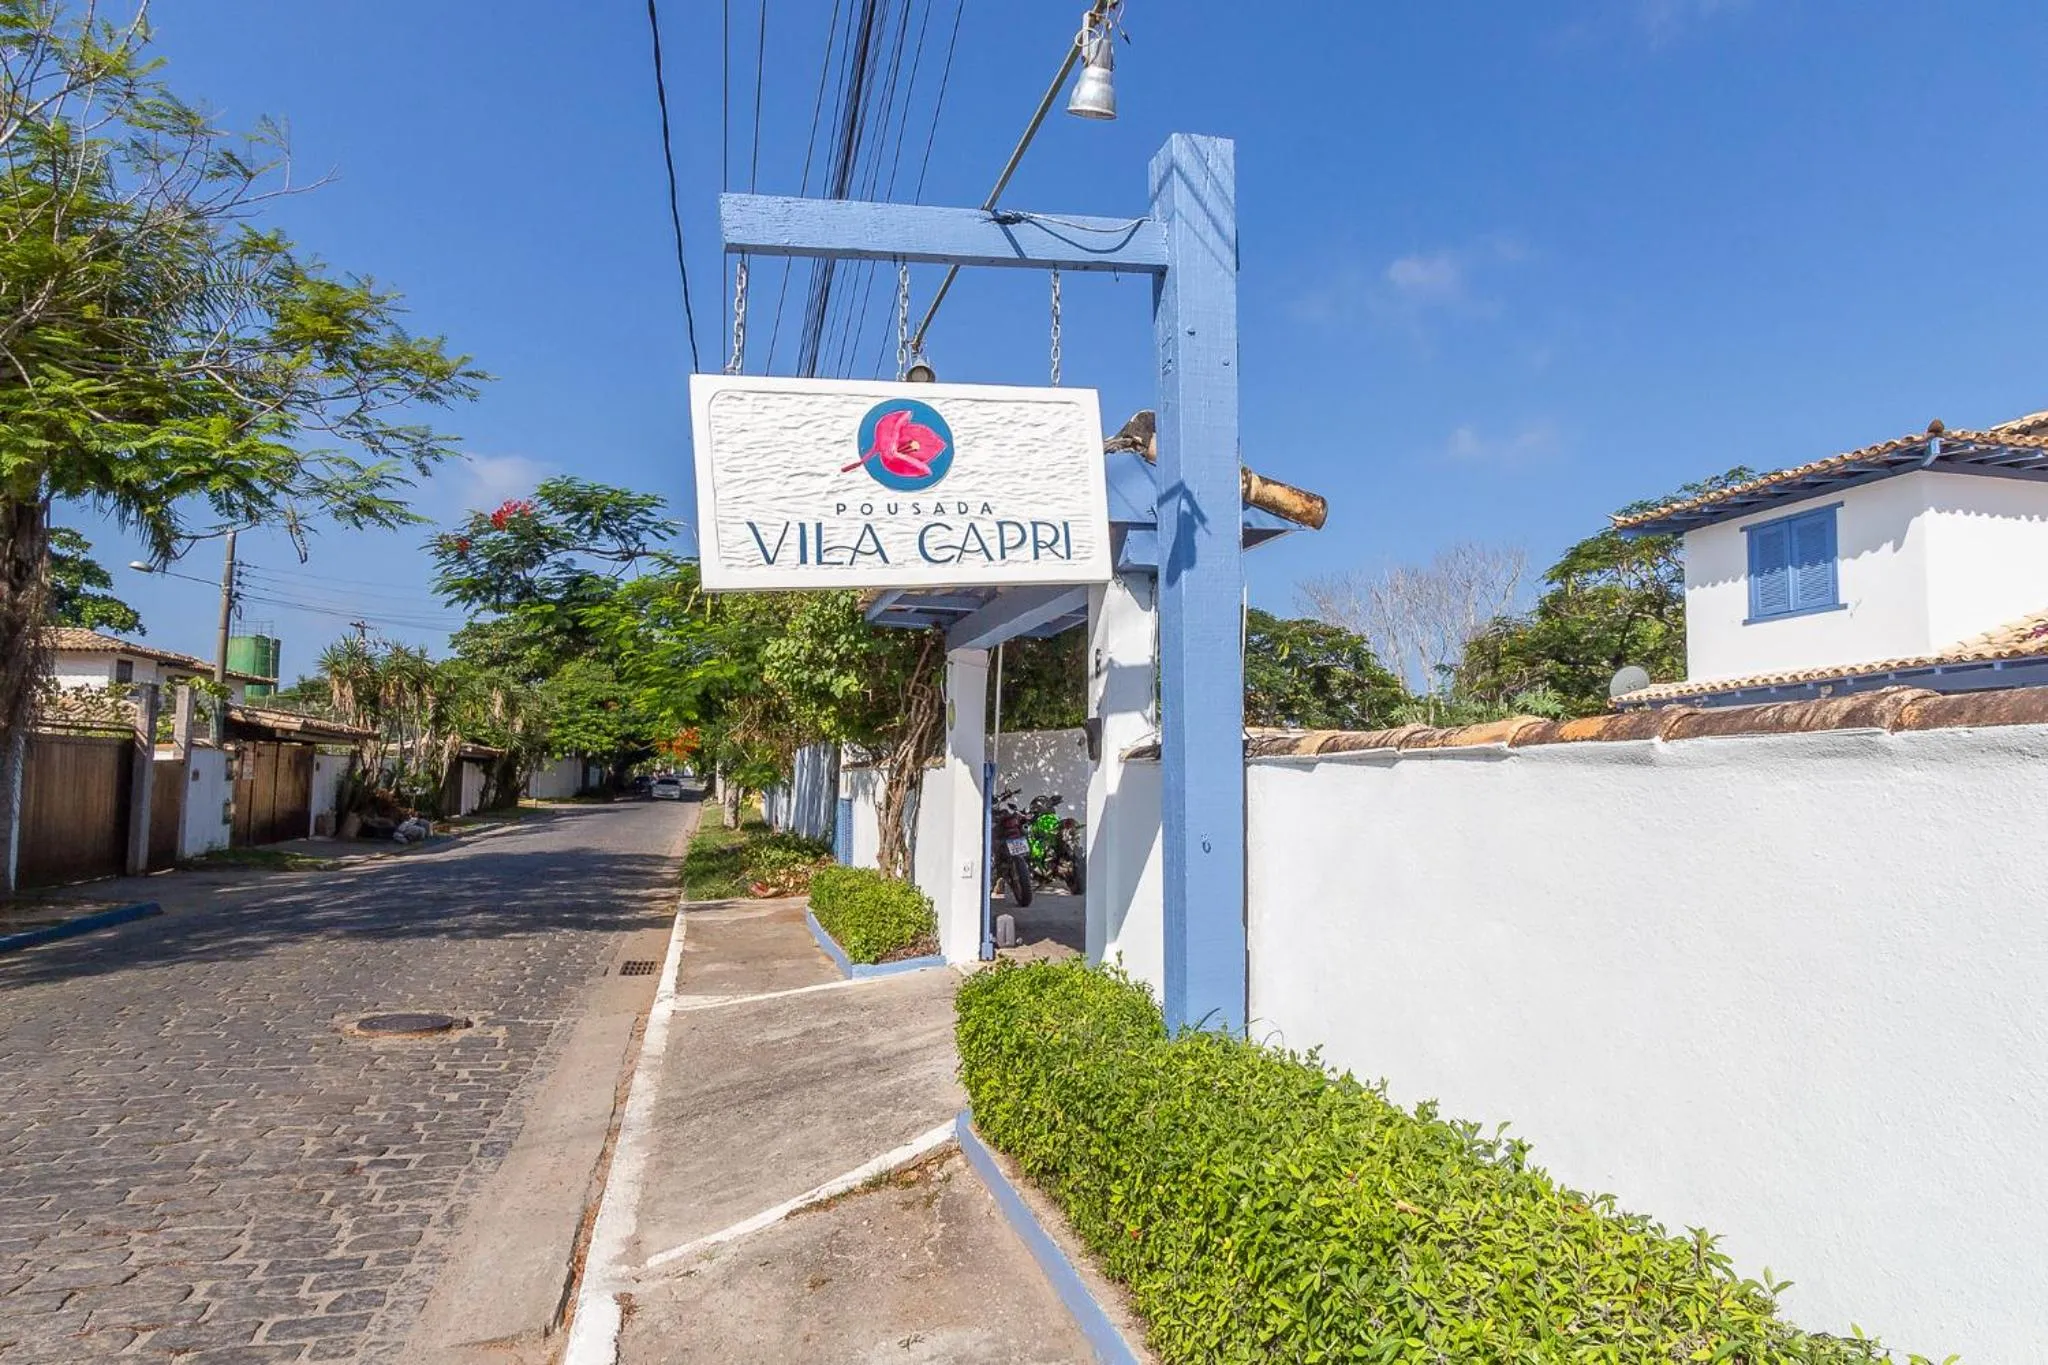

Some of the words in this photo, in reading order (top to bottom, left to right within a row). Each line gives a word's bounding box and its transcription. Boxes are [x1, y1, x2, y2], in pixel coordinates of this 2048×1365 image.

[836, 502, 992, 515] POUSADA
[746, 521, 890, 565] VILA
[918, 520, 1071, 563] CAPRI
